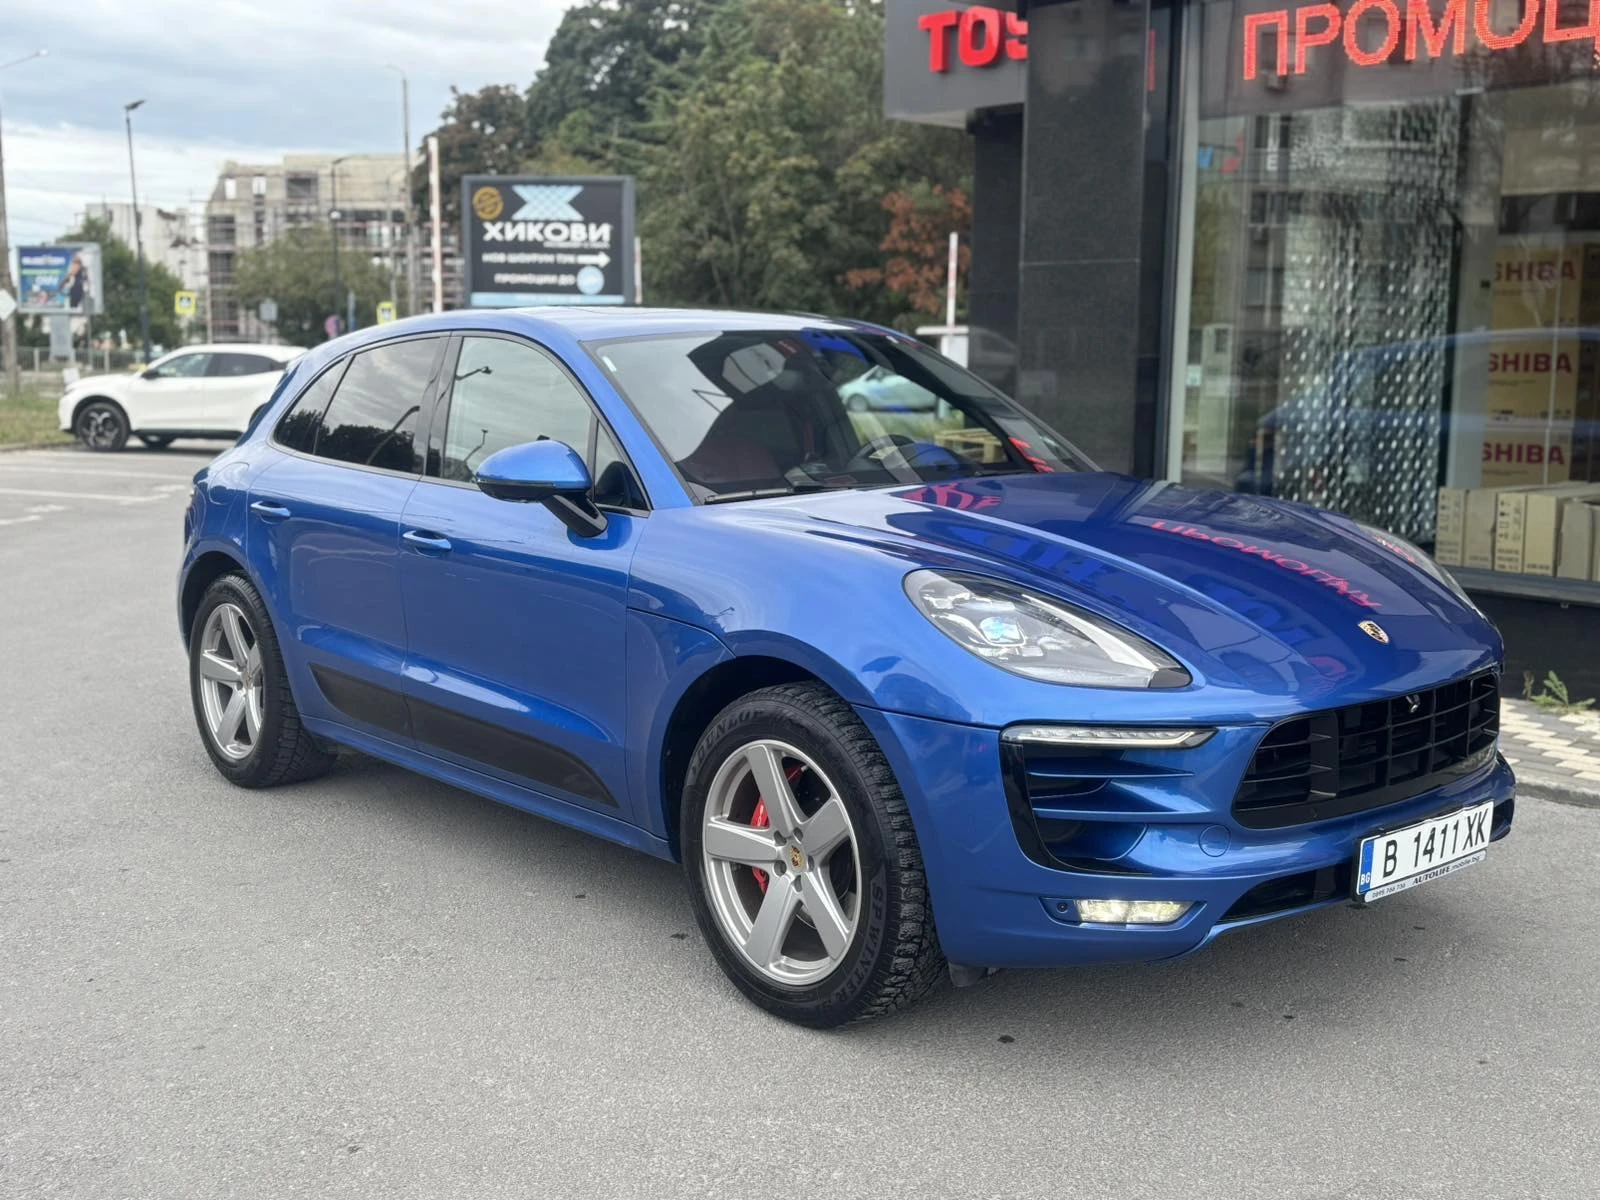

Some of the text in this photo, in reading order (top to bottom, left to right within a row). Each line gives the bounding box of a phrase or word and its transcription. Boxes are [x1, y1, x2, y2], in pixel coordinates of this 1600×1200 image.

[483, 221, 612, 242] ХИКОВИ
[1383, 807, 1489, 879] B 1411 XK
[1360, 871, 1371, 885] BG
[1412, 865, 1451, 885] AUTOLIFE
